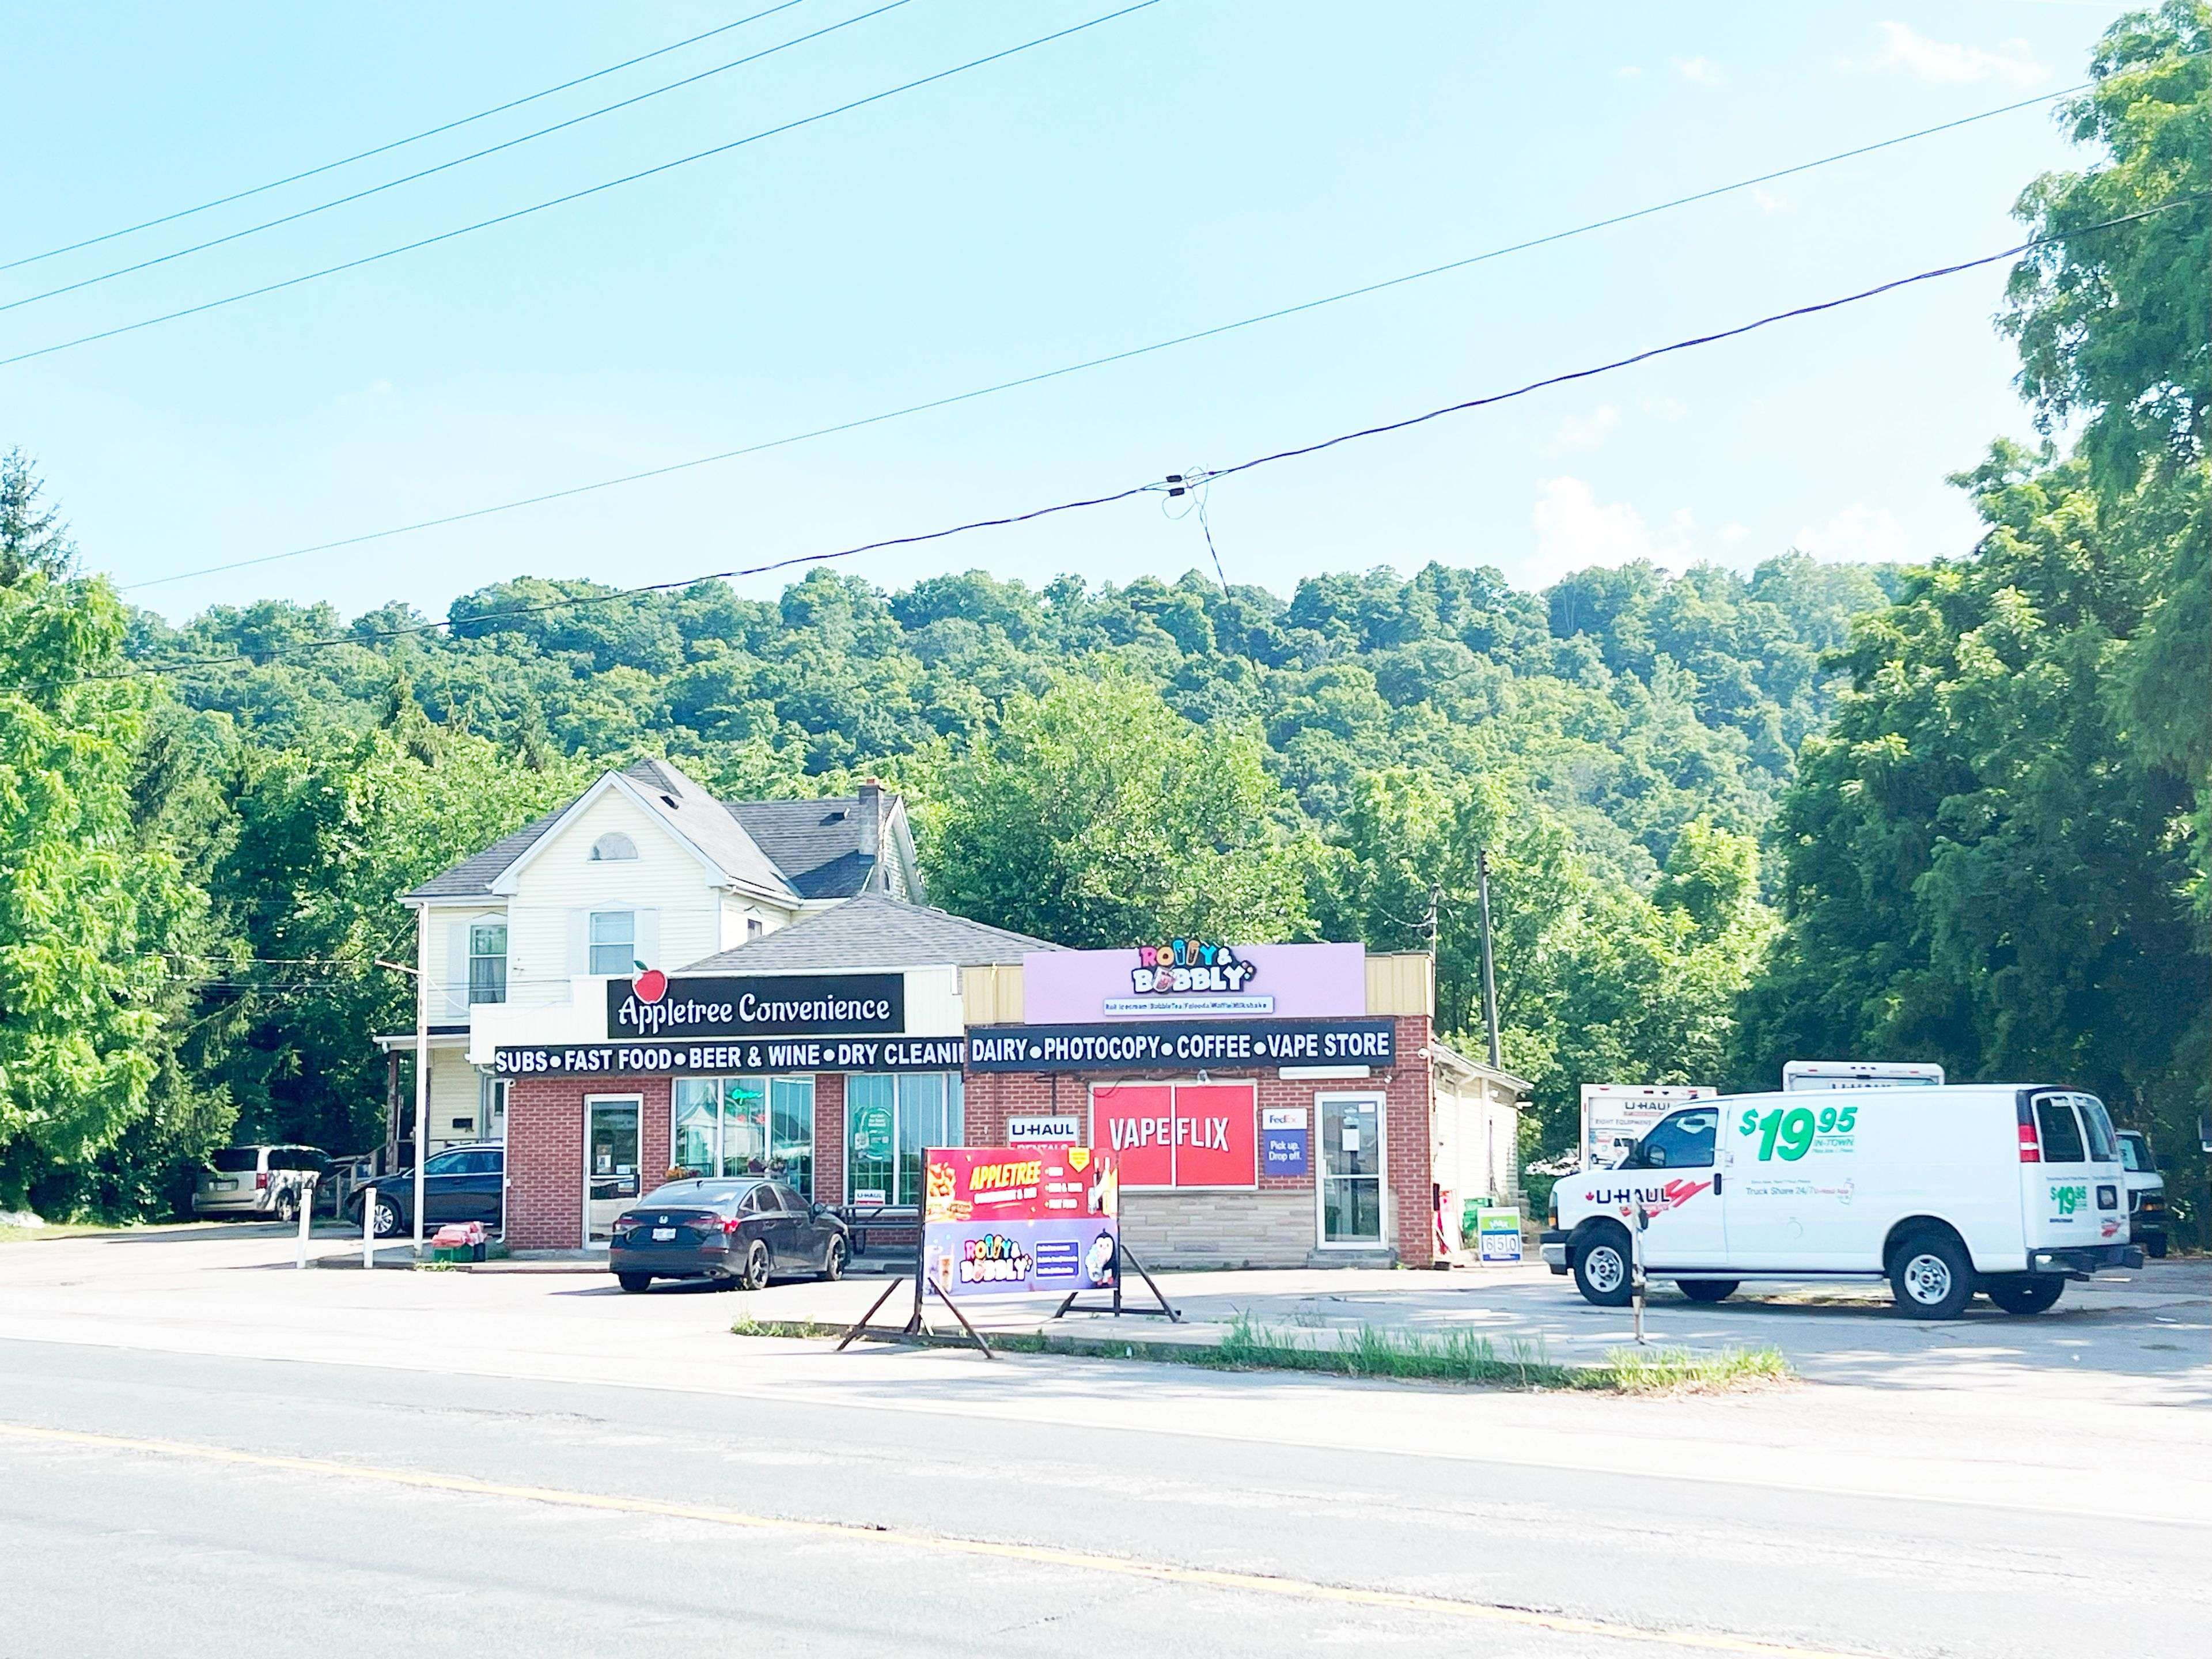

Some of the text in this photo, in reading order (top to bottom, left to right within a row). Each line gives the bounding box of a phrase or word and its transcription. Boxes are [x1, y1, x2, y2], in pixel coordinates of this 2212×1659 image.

[618, 993, 889, 1035] Appletree Convenience
[972, 1032, 1389, 1061] DAIRY PHOTOCOPY COFFEE VAPE STORE
[495, 1051, 547, 1072] SUBS
[565, 1050, 613, 1071] FAST
[619, 1048, 672, 1070] FOOD
[690, 1046, 741, 1068] BEER
[747, 1046, 762, 1067] &
[768, 1044, 820, 1066] WINE
[838, 1043, 878, 1065] DRY
[1270, 1115, 1297, 1123] FedEx
[1012, 1124, 1074, 1135] U-HAUL
[1270, 1140, 1286, 1150] Pick
[1268, 1152, 1288, 1162] Drop
[969, 1160, 1042, 1191] APPLETREE
[1596, 1188, 1670, 1204] U-HAUL
[1771, 1187, 1794, 1195] Share
